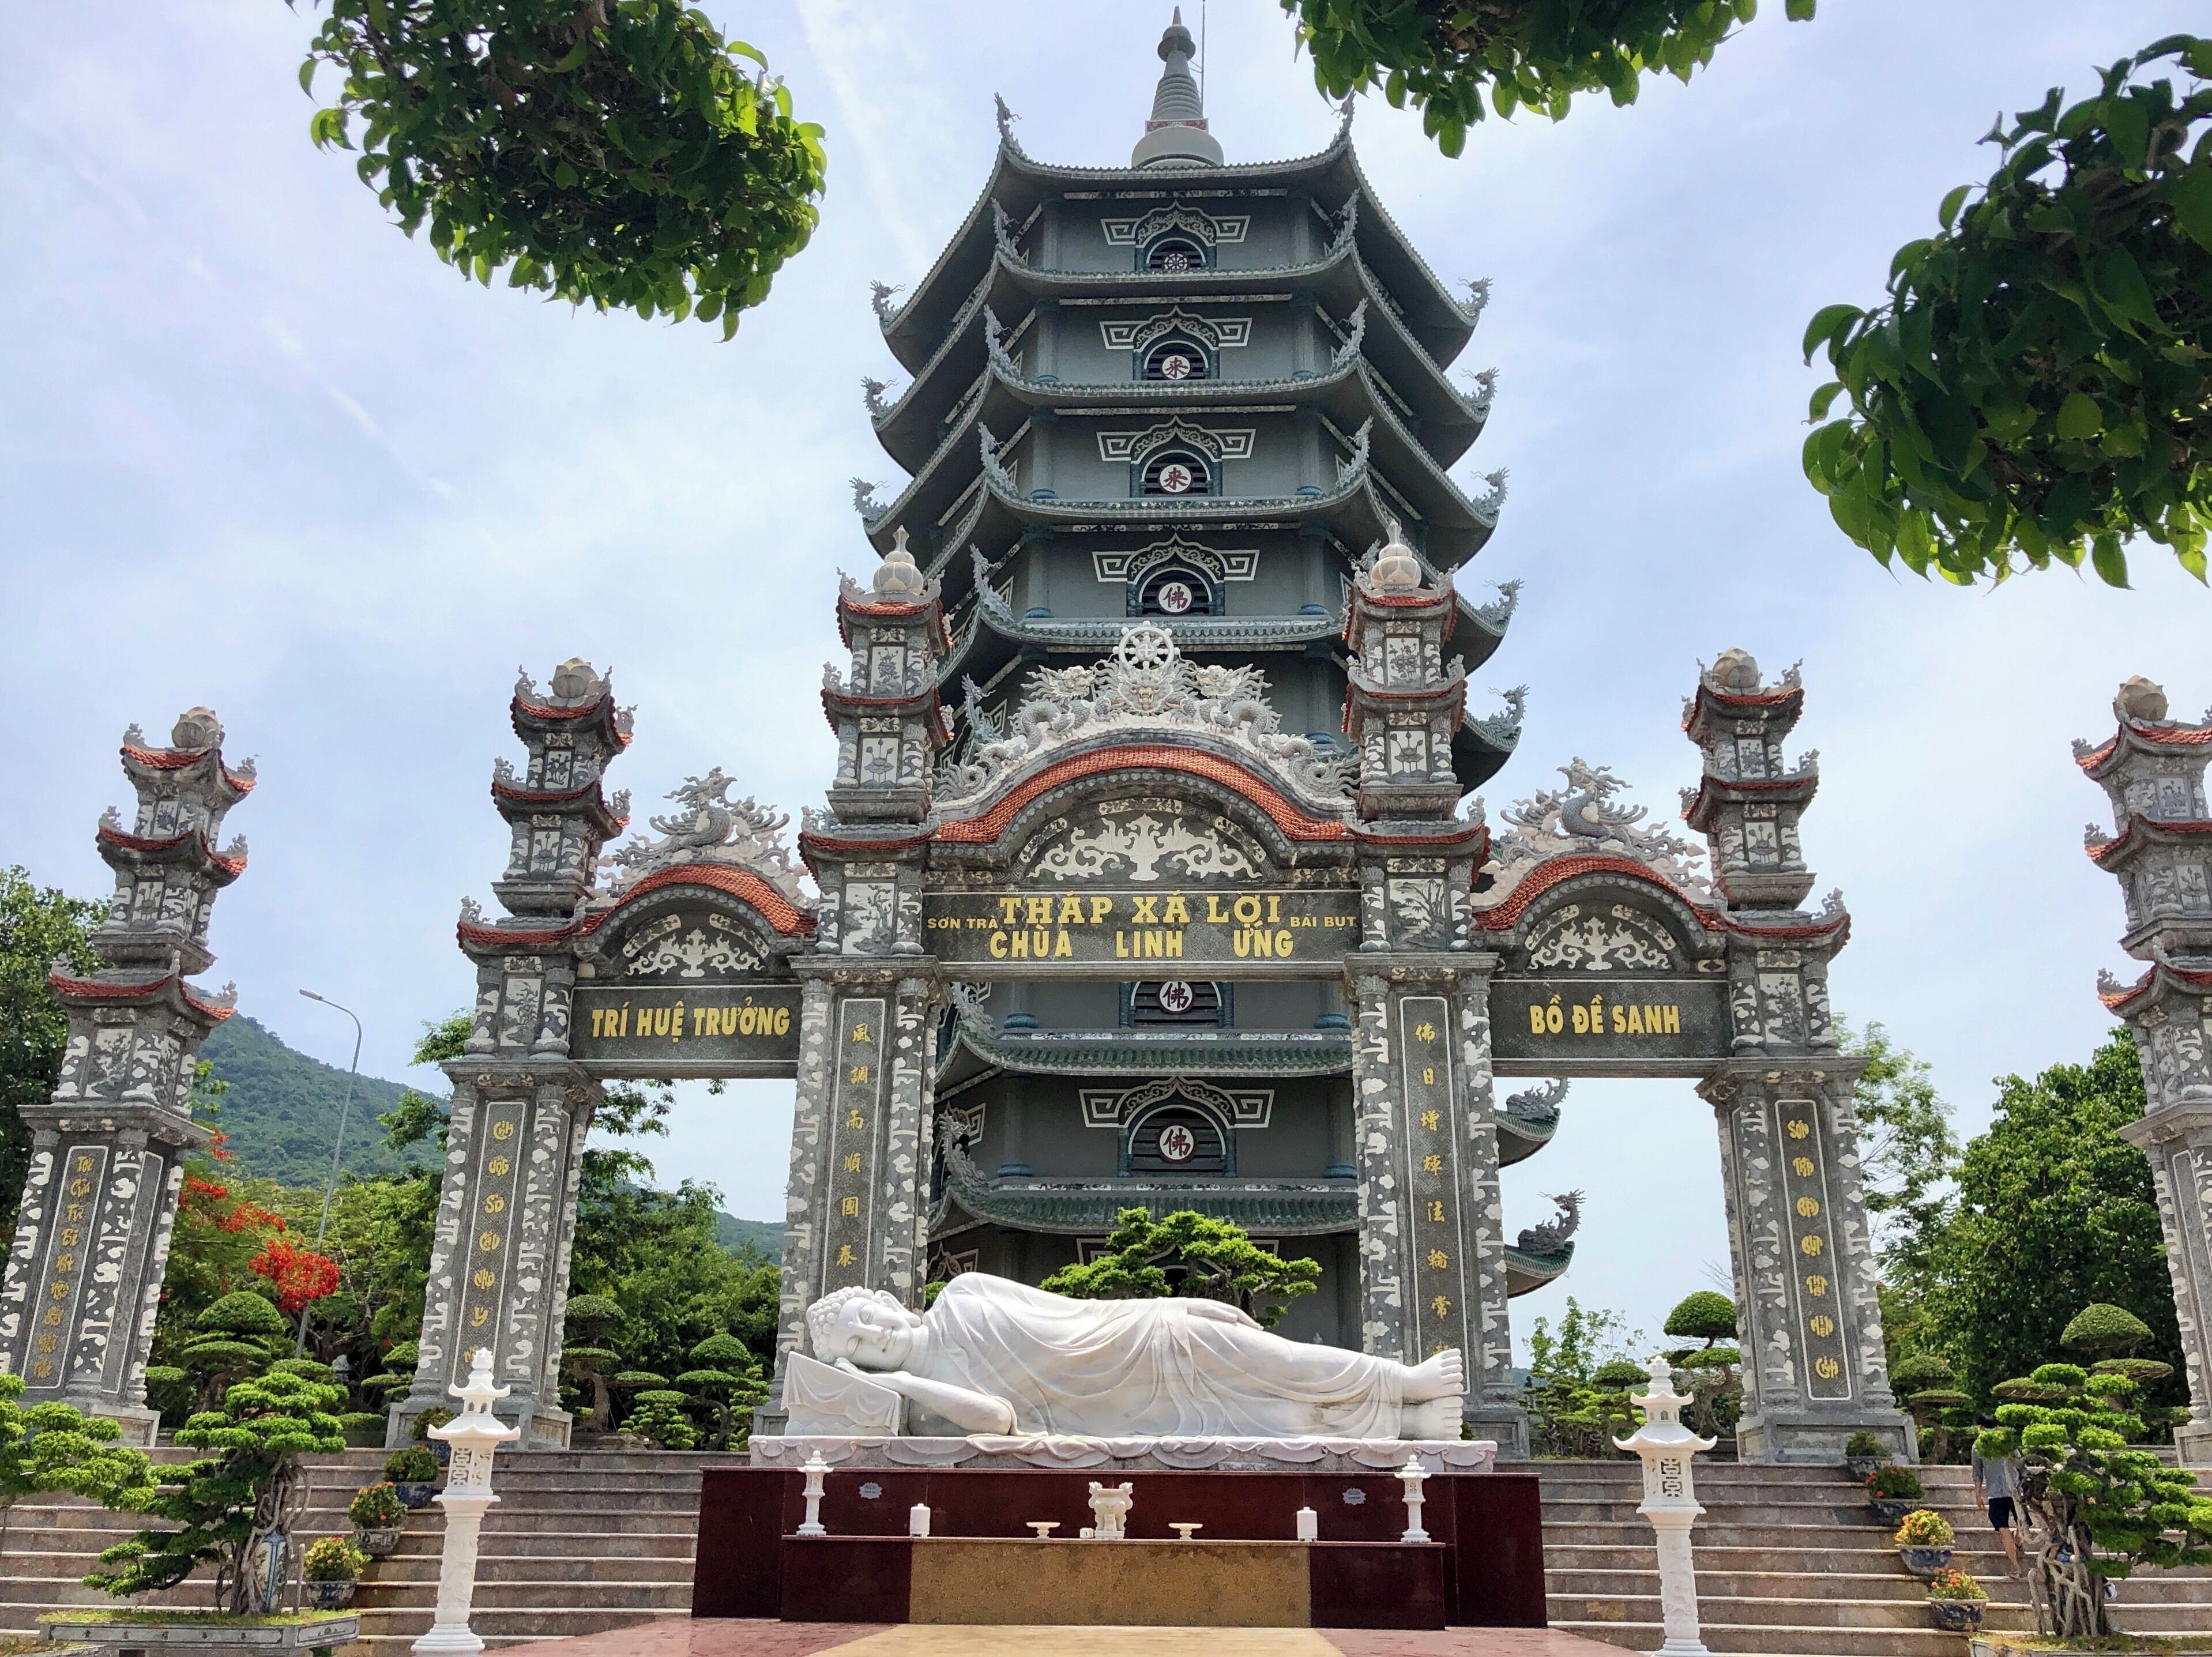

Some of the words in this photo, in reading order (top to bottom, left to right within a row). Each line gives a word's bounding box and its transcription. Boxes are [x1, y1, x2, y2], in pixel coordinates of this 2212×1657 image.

[1162, 585, 1188, 609] 佛
[927, 916, 961, 929] SƠN
[966, 916, 998, 929] TRÀ
[1000, 890, 1113, 924] THÁP
[1132, 890, 1190, 923] XÁ
[1207, 895, 1281, 928] LỢI
[1291, 913, 1316, 928] BÃI
[1325, 916, 1357, 931] BỤT
[990, 924, 1073, 958] CHÙA
[1116, 931, 1182, 958] LINH
[1233, 920, 1293, 958] ỨNG
[1162, 981, 1189, 1008] 佛
[592, 1001, 630, 1037] TRÍ
[637, 1000, 684, 1043] HUỆ
[694, 996, 790, 1035] TRƯỞNG
[1612, 1005, 1680, 1034] SANH
[1163, 1127, 1191, 1157] 佛
[1415, 1022, 1451, 1355] 佛日增輝法輪常
